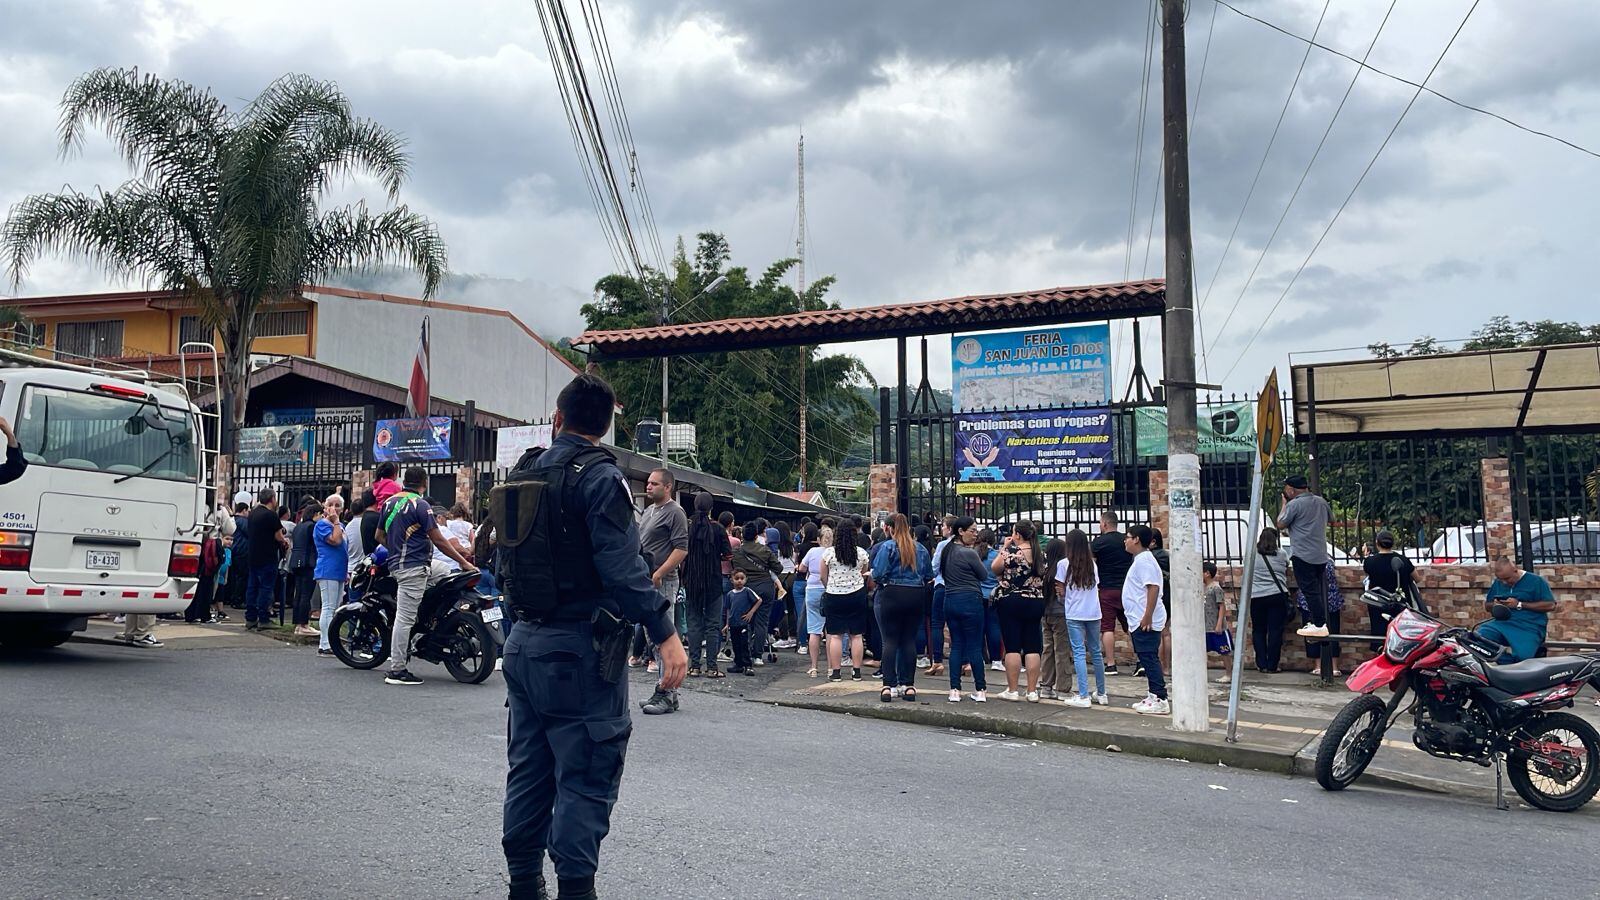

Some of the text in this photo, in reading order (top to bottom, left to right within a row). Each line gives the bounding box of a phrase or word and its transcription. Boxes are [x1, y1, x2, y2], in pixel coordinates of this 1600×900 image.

[1024, 332, 1062, 346] FERIA
[985, 343, 1104, 362] SAN JUAN DE DIOS
[997, 361, 1031, 375] Sábado
[1031, 361, 1039, 373] 5
[1069, 359, 1082, 370] 12
[341, 414, 363, 423] DIOS
[959, 414, 1107, 431] Problemas con drogas?
[1006, 433, 1110, 446] Narcóticos Anónimos
[1197, 434, 1253, 444] GENERACIÓN
[1038, 449, 1076, 457] Reuniones
[1012, 457, 1103, 467] Lunes, Martes y Jueves
[1023, 467, 1040, 475] 7:00
[1041, 467, 1054, 475] pm
[1079, 466, 1092, 474] pm
[3, 512, 26, 521] 4501
[83, 528, 138, 537] COASTER
